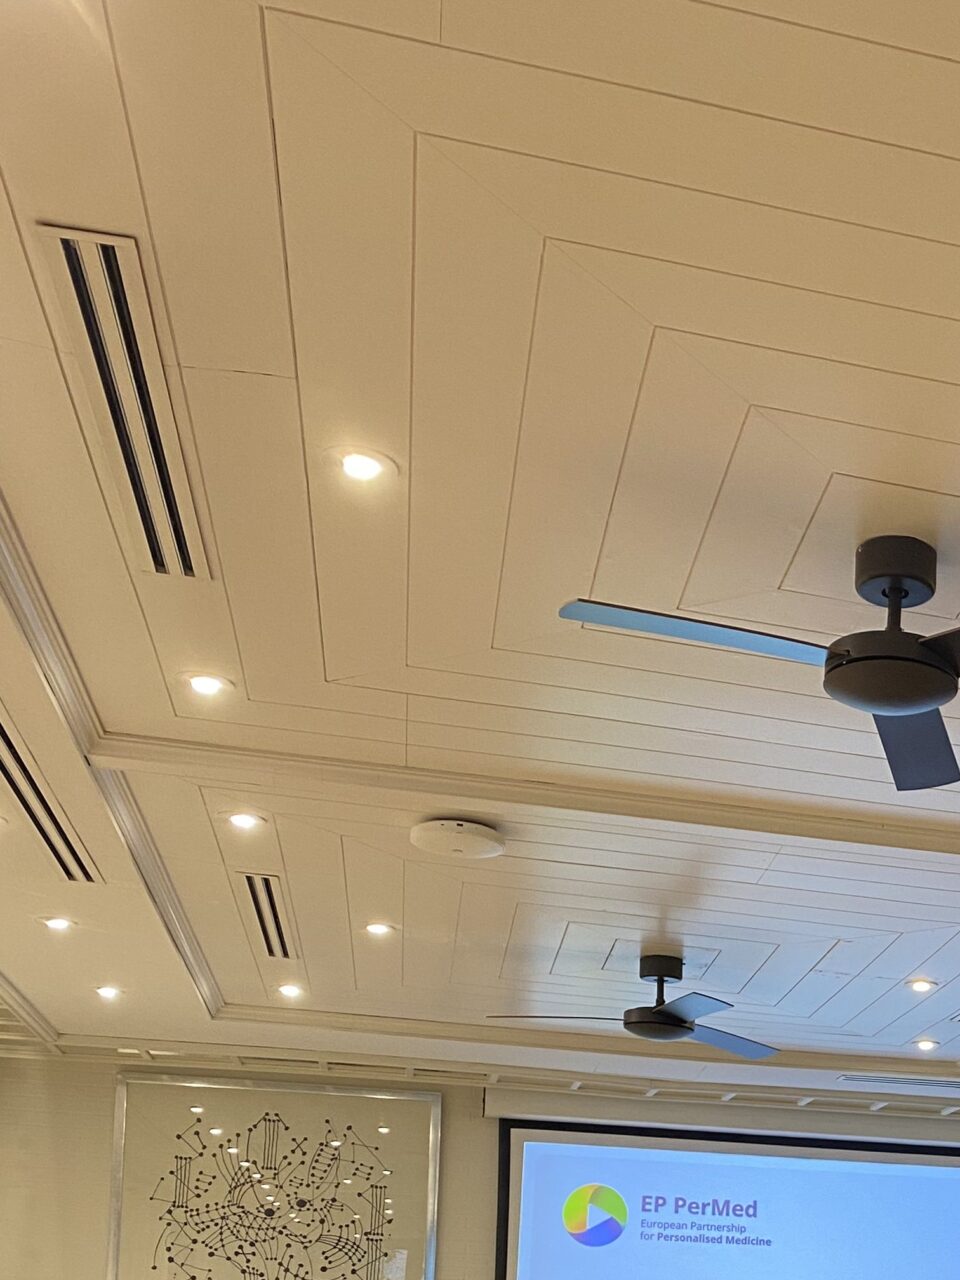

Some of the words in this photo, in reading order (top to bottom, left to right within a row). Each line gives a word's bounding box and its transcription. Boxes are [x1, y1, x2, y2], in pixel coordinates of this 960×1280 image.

[641, 1195, 667, 1213] EP
[674, 1197, 758, 1218] PerMed
[640, 1219, 688, 1231] European
[690, 1221, 747, 1235] Partnership
[640, 1231, 655, 1241] for
[657, 1232, 723, 1245] Personalised
[725, 1235, 772, 1247] Medicine
